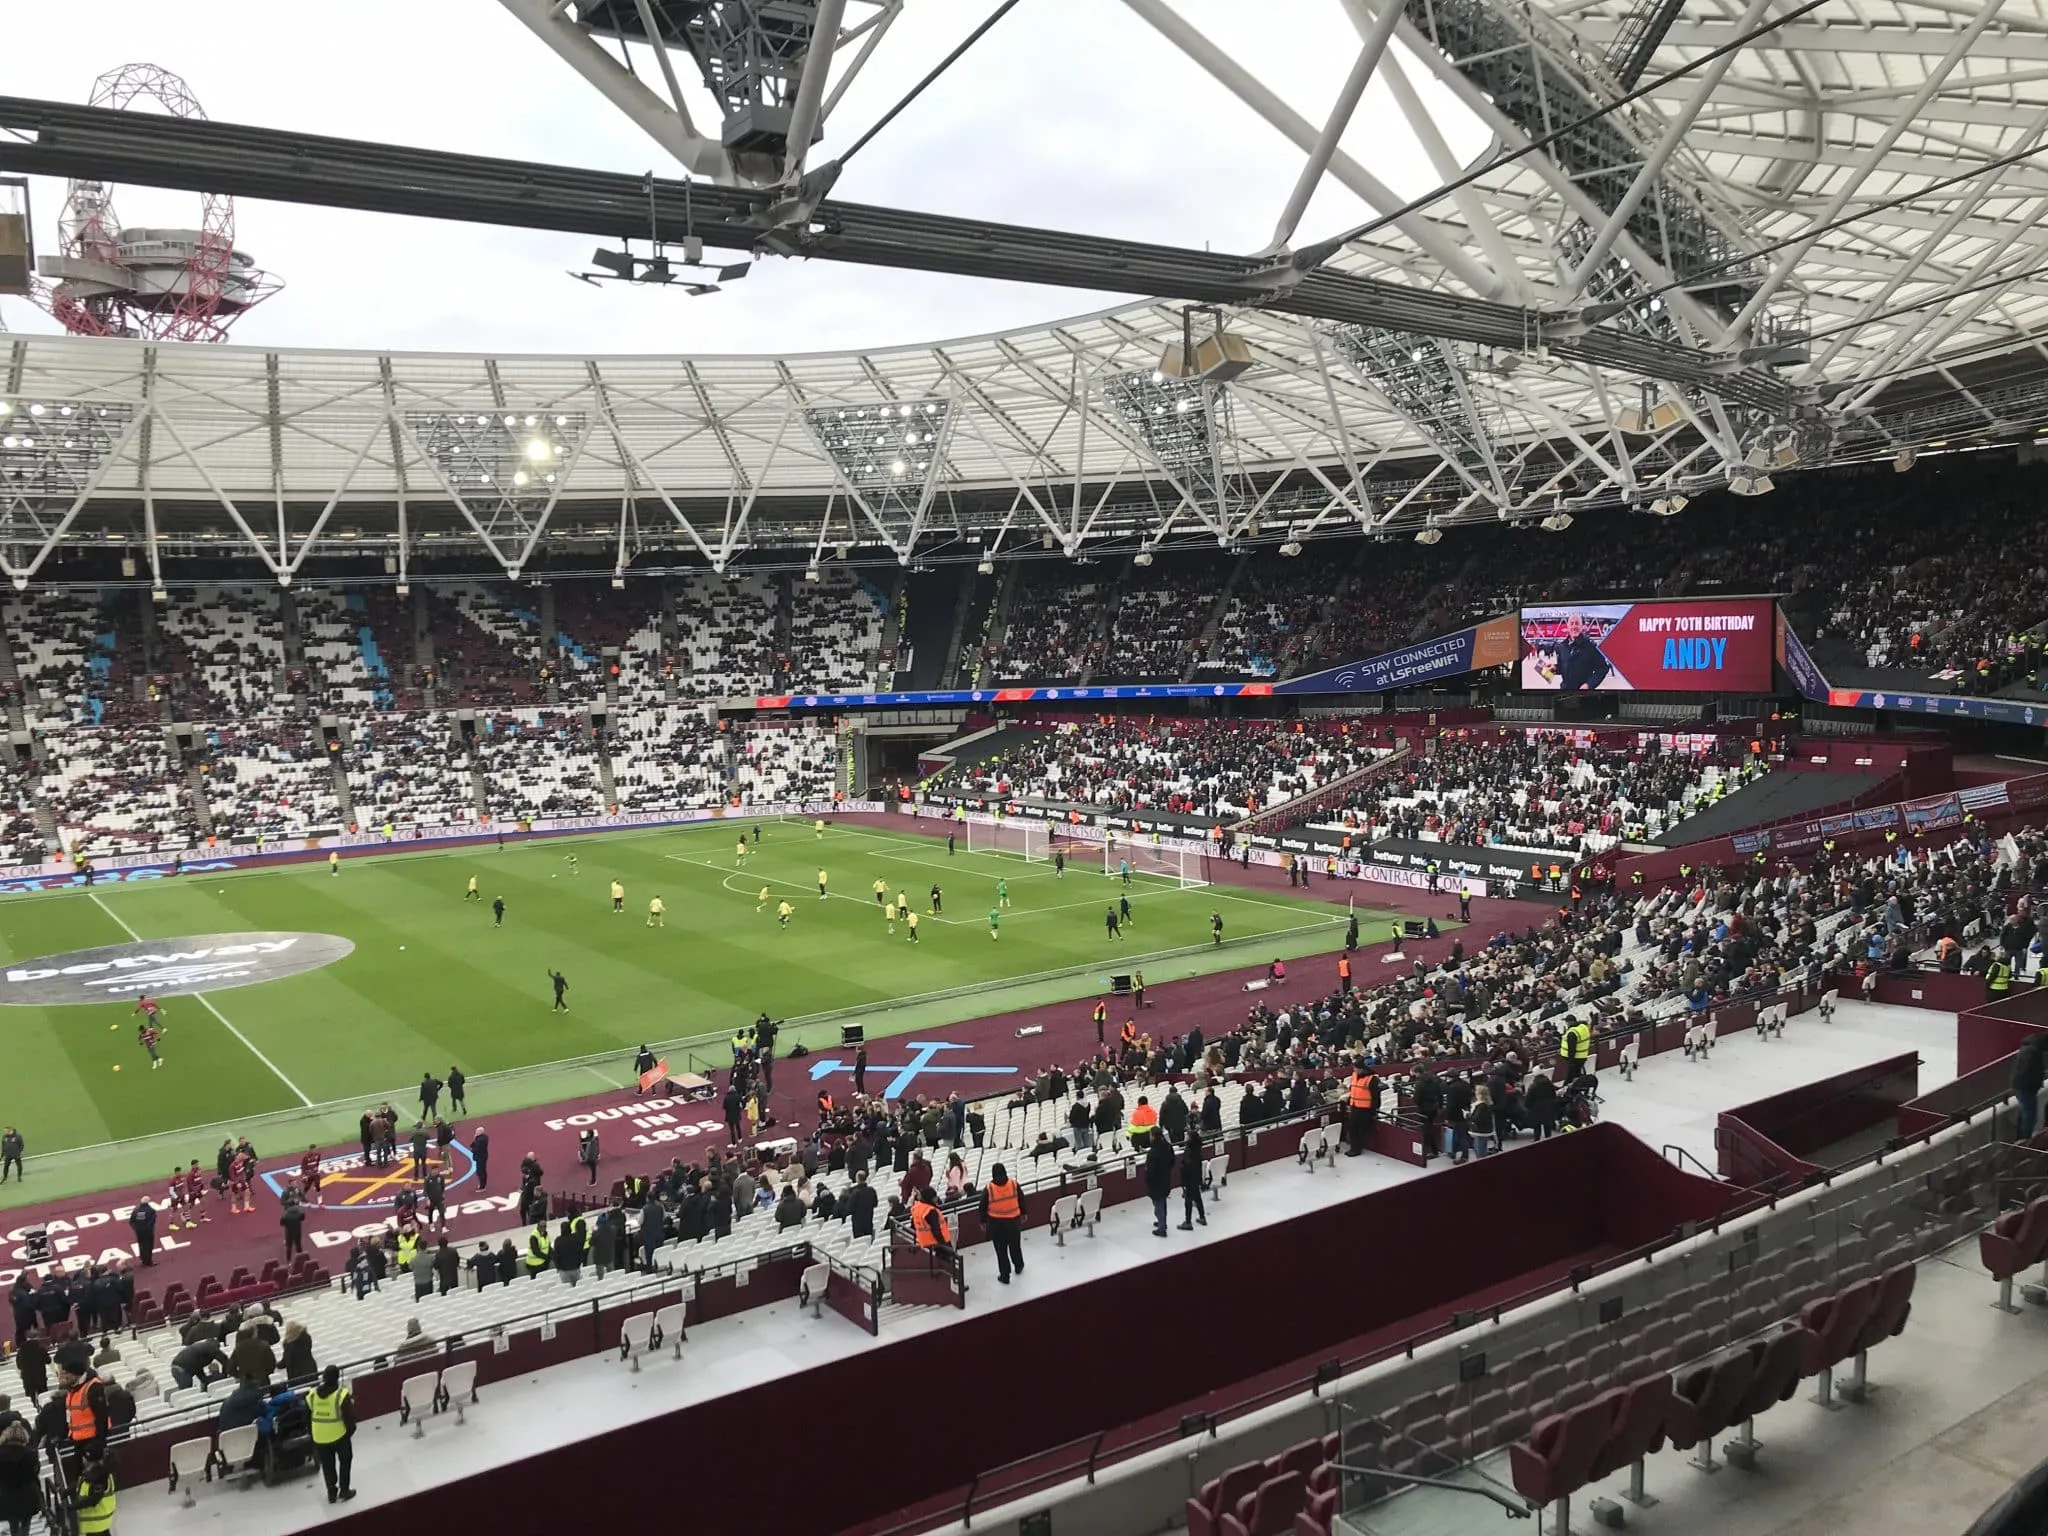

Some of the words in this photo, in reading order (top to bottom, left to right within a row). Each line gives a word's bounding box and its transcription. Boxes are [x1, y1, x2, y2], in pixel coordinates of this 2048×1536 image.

[1639, 616, 1672, 632] HAPPY
[1674, 616, 1703, 632] 70TH
[1704, 615, 1755, 631] BIRTHDAY
[1361, 660, 1391, 677] STAY
[1393, 637, 1466, 668] CONNECTED
[1662, 637, 1728, 670] ANDY
[1376, 674, 1389, 686] at
[1282, 838, 1309, 851] betway
[1373, 850, 1404, 864] betway
[1448, 859, 1482, 874] betway
[1489, 863, 1524, 879] betway
[6, 937, 299, 982] betway
[107, 970, 250, 993] umbro
[632, 1112, 679, 1129] IN
[630, 1119, 725, 1147] 1895
[11, 1235, 79, 1260] OF
